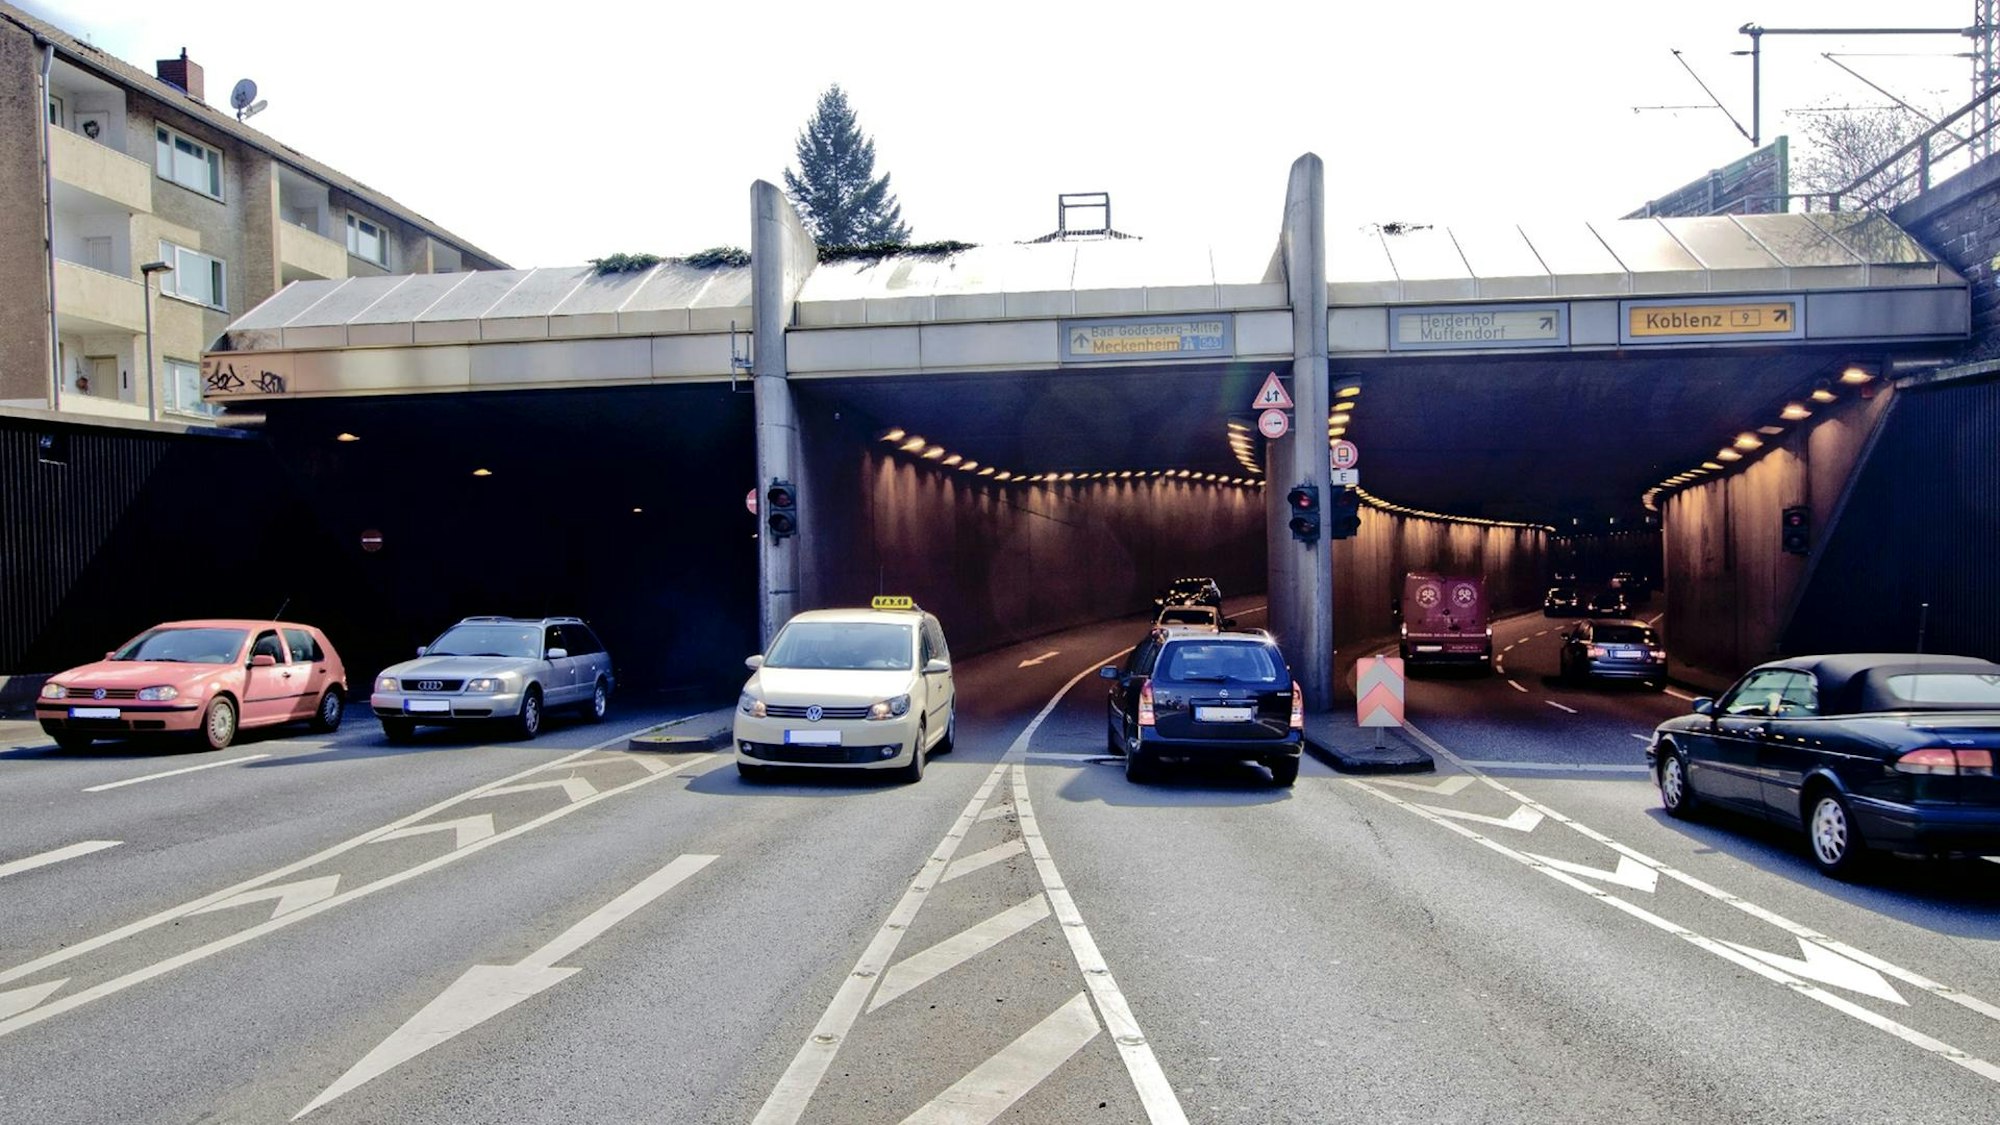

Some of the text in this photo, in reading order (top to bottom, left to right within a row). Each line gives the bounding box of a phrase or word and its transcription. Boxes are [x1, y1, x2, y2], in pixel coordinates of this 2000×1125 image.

[1421, 313, 1497, 328] Heiderhof
[1647, 313, 1749, 329] Koblenz 9
[1092, 322, 1221, 337] Bad Godesberg-Mitte
[1421, 326, 1506, 341] Muffendorf
[1093, 337, 1180, 353] Meckenheim
[1340, 472, 1347, 482] E
[875, 597, 907, 606] TAXI
